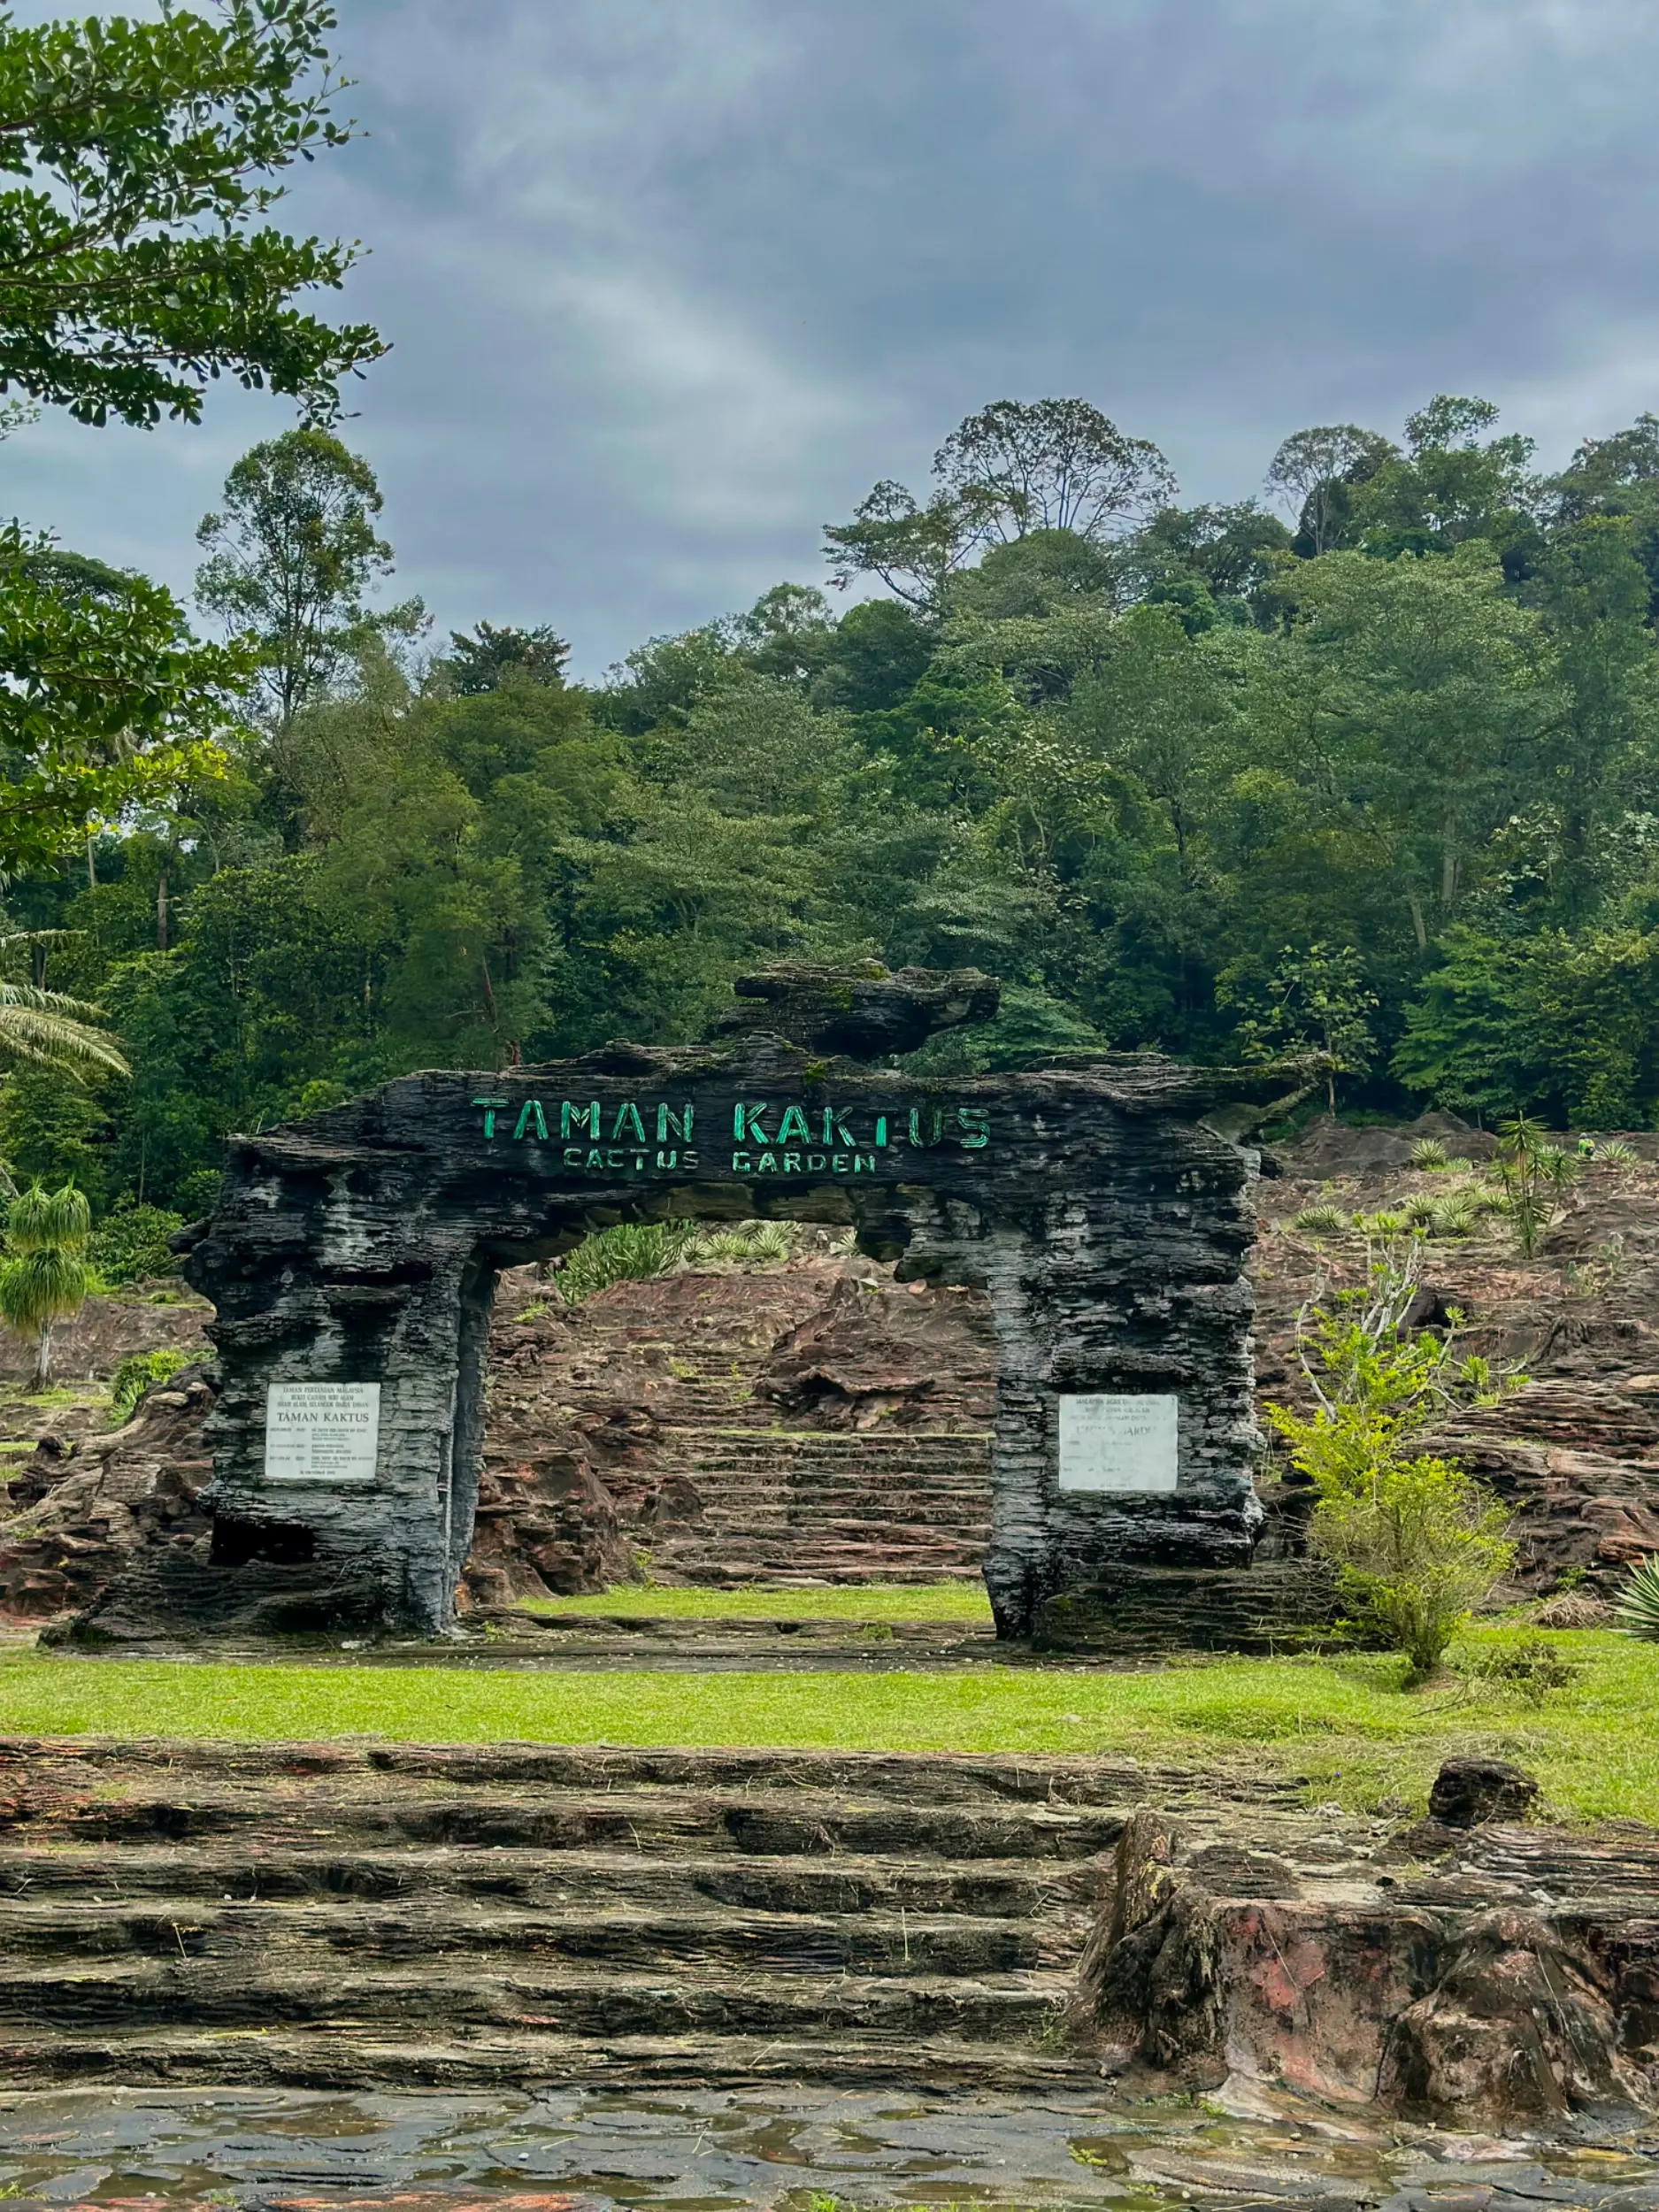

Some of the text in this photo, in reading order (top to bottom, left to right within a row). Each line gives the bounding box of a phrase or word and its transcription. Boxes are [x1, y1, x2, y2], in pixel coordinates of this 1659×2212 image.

[471, 1097, 992, 1149] TAMAN KAKTUS
[563, 1148, 876, 1173] CACTUS GARDEN
[277, 1412, 370, 1423] TAMAN KAKTUS
